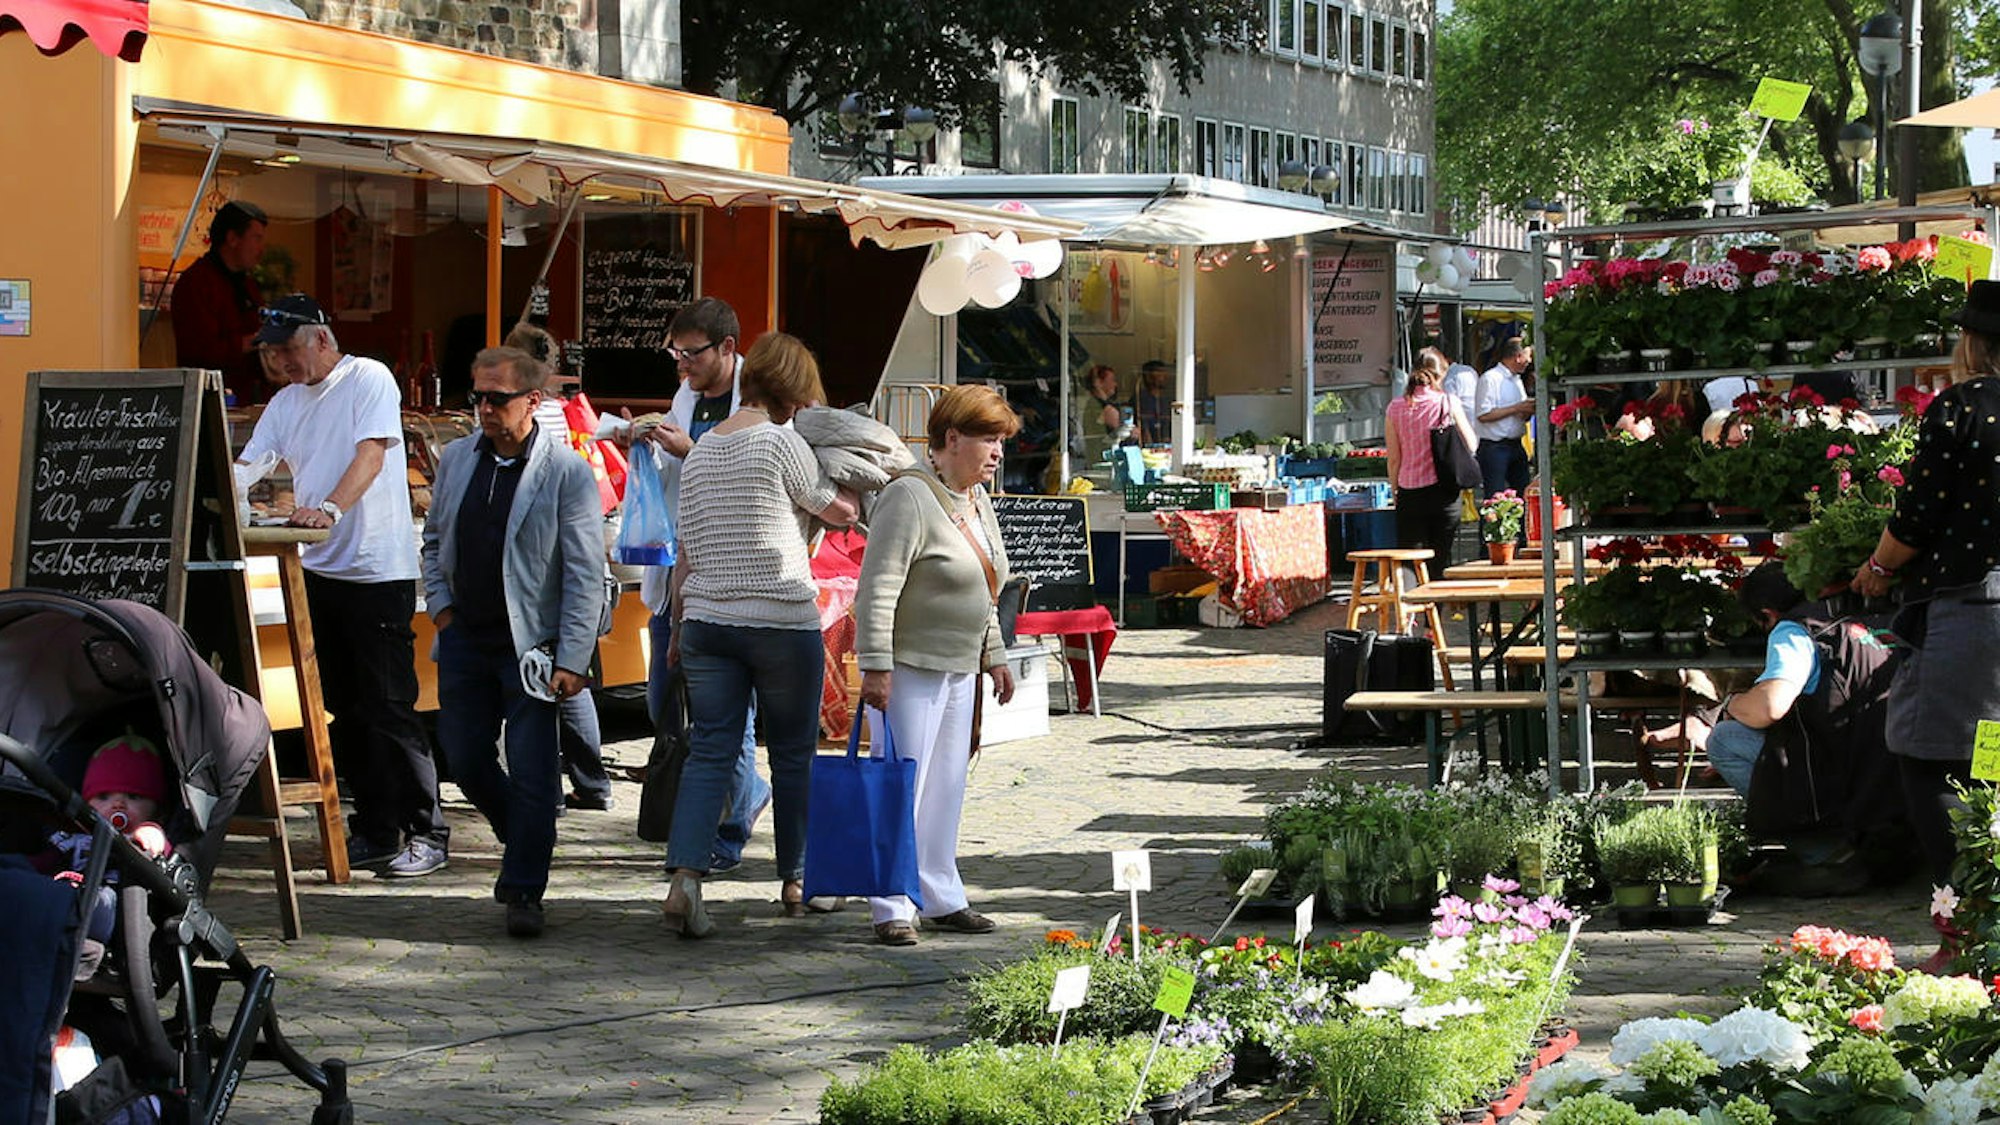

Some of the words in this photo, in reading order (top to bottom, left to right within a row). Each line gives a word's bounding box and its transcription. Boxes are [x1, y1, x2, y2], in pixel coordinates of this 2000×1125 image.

[136, 436, 166, 450] aus
[87, 497, 115, 513] nur
[29, 543, 171, 588] selbsteingelegter
